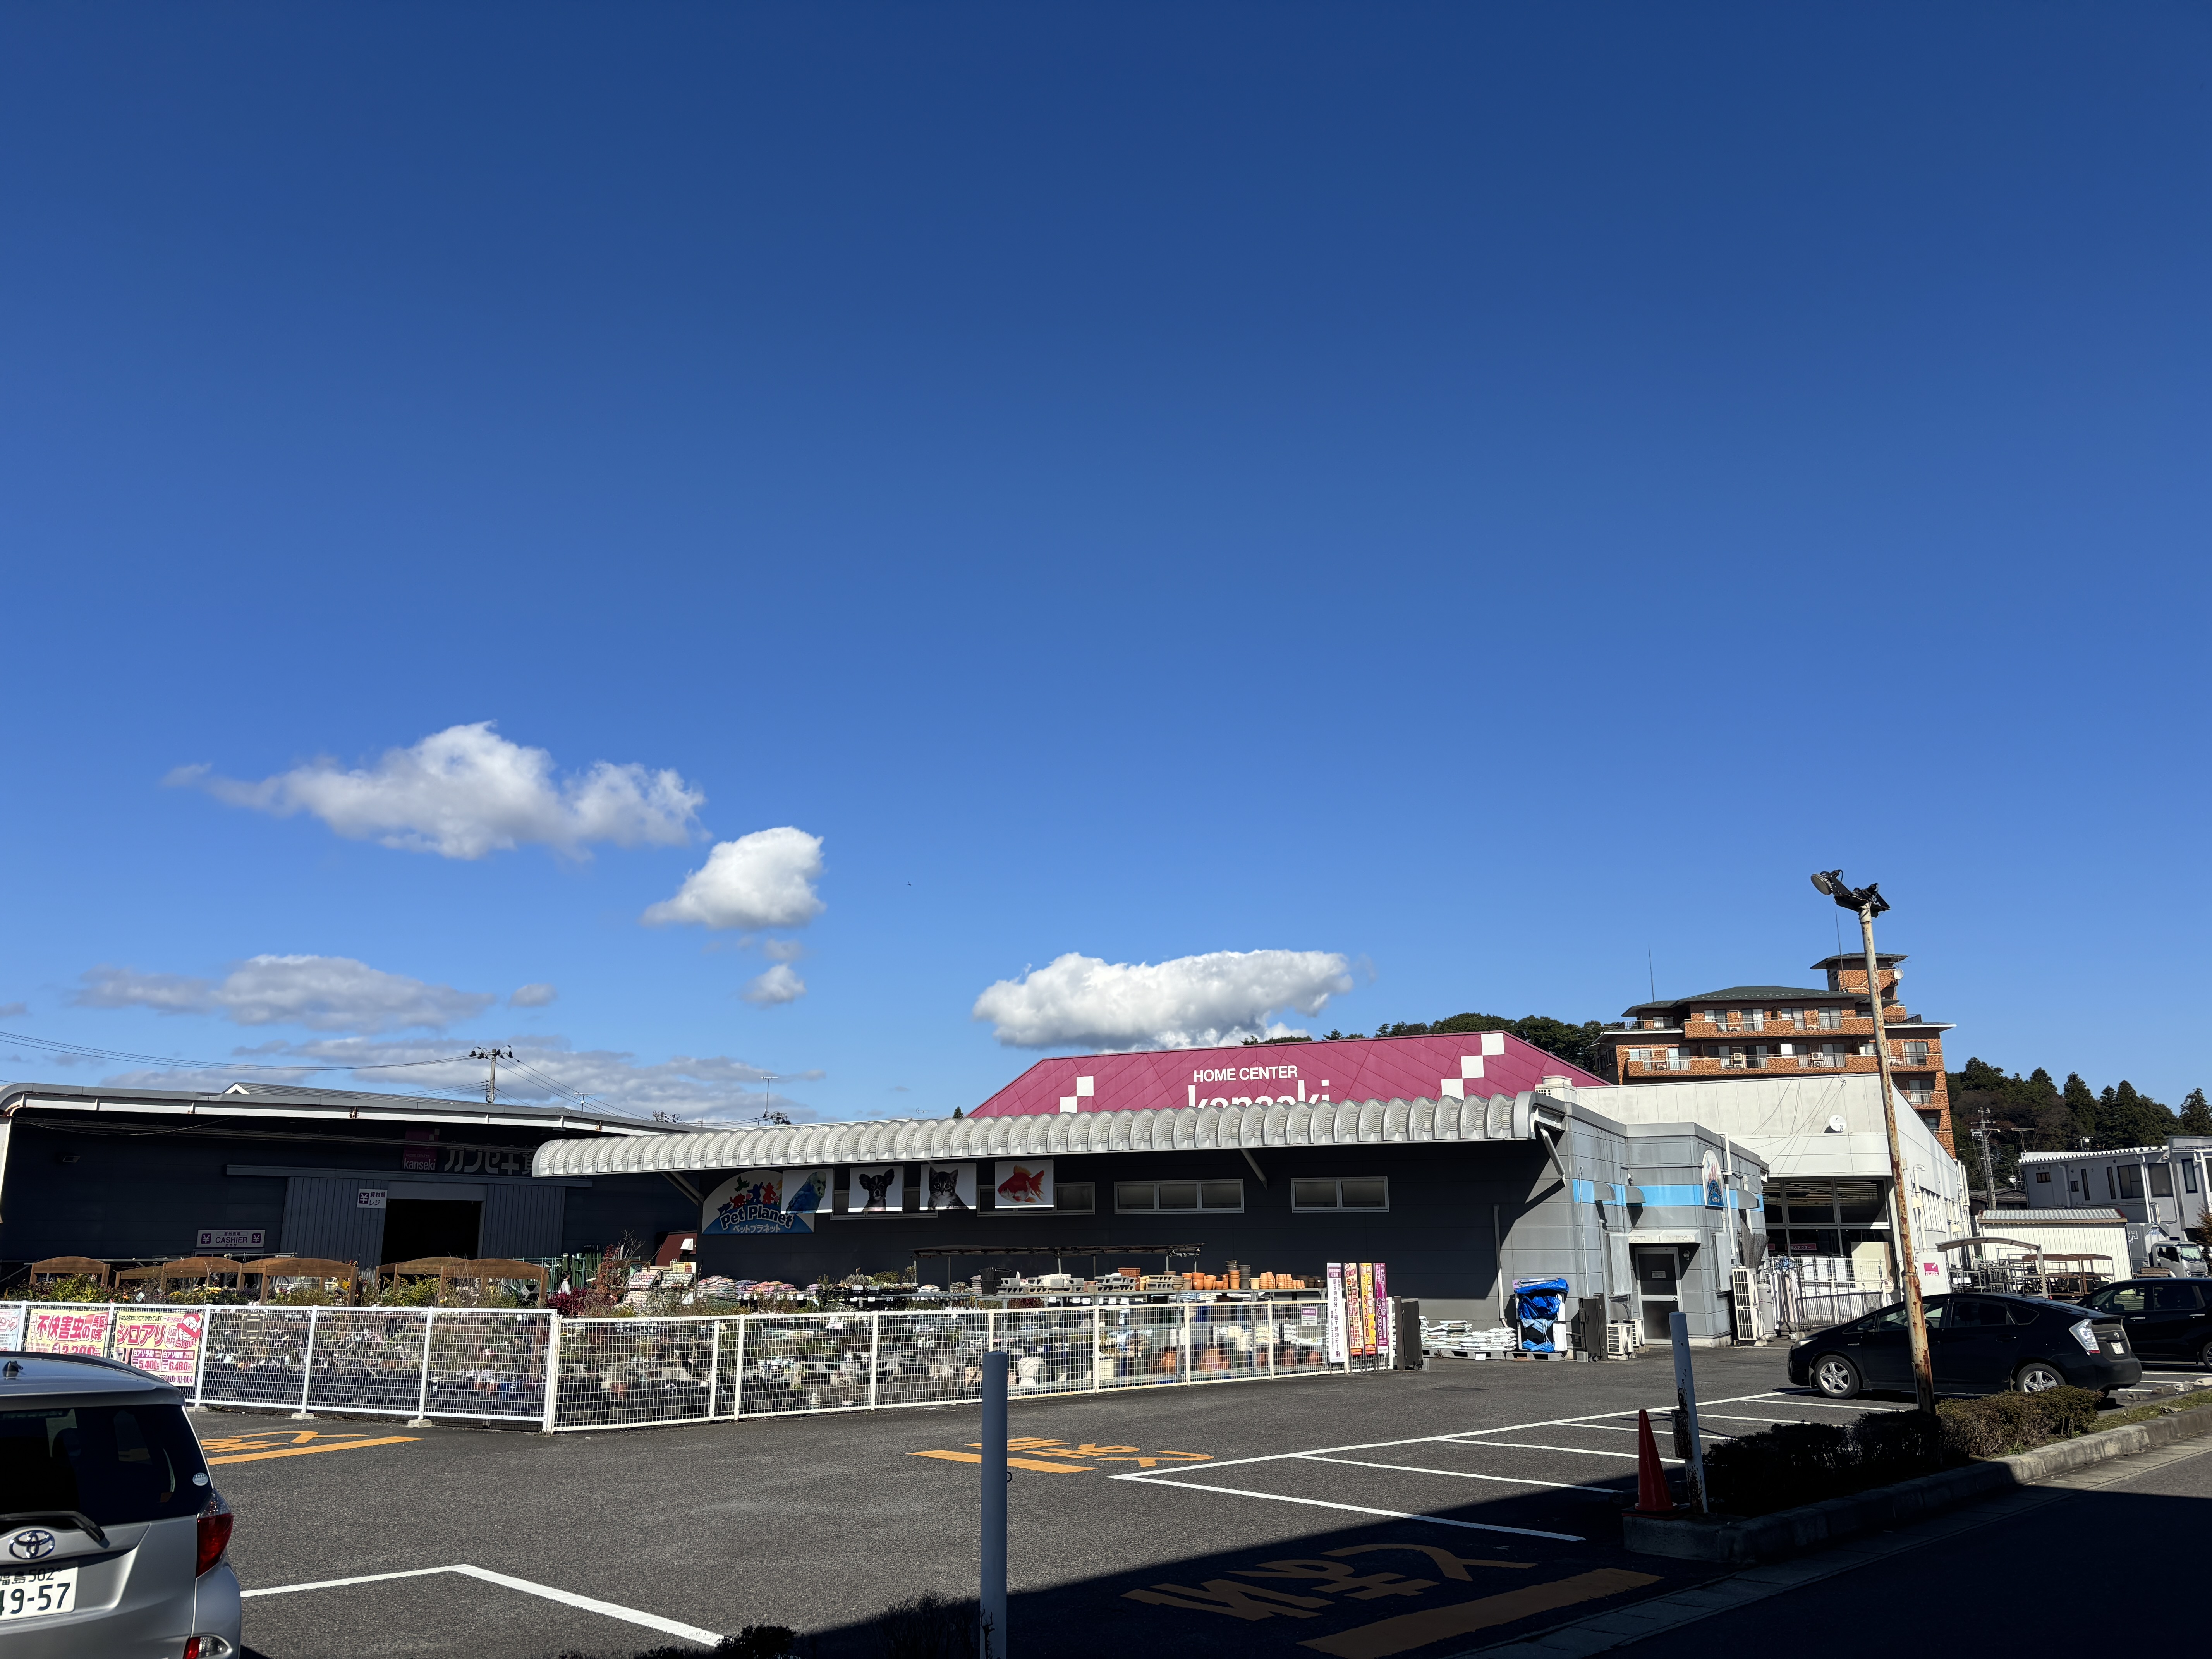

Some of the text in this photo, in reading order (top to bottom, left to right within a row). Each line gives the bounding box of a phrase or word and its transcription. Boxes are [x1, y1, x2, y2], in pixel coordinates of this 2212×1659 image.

[1194, 1065, 1298, 1082] HOME CENTER
[404, 1157, 436, 1170] kanseki
[720, 1204, 795, 1231] Pet Planet
[733, 1223, 781, 1233] ペットプラネット
[117, 1322, 166, 1347] シロアリ
[175, 1337, 197, 1349] Stop!
[28, 1568, 54, 1582] 502
[1120, 1544, 1538, 1621] とまれ
